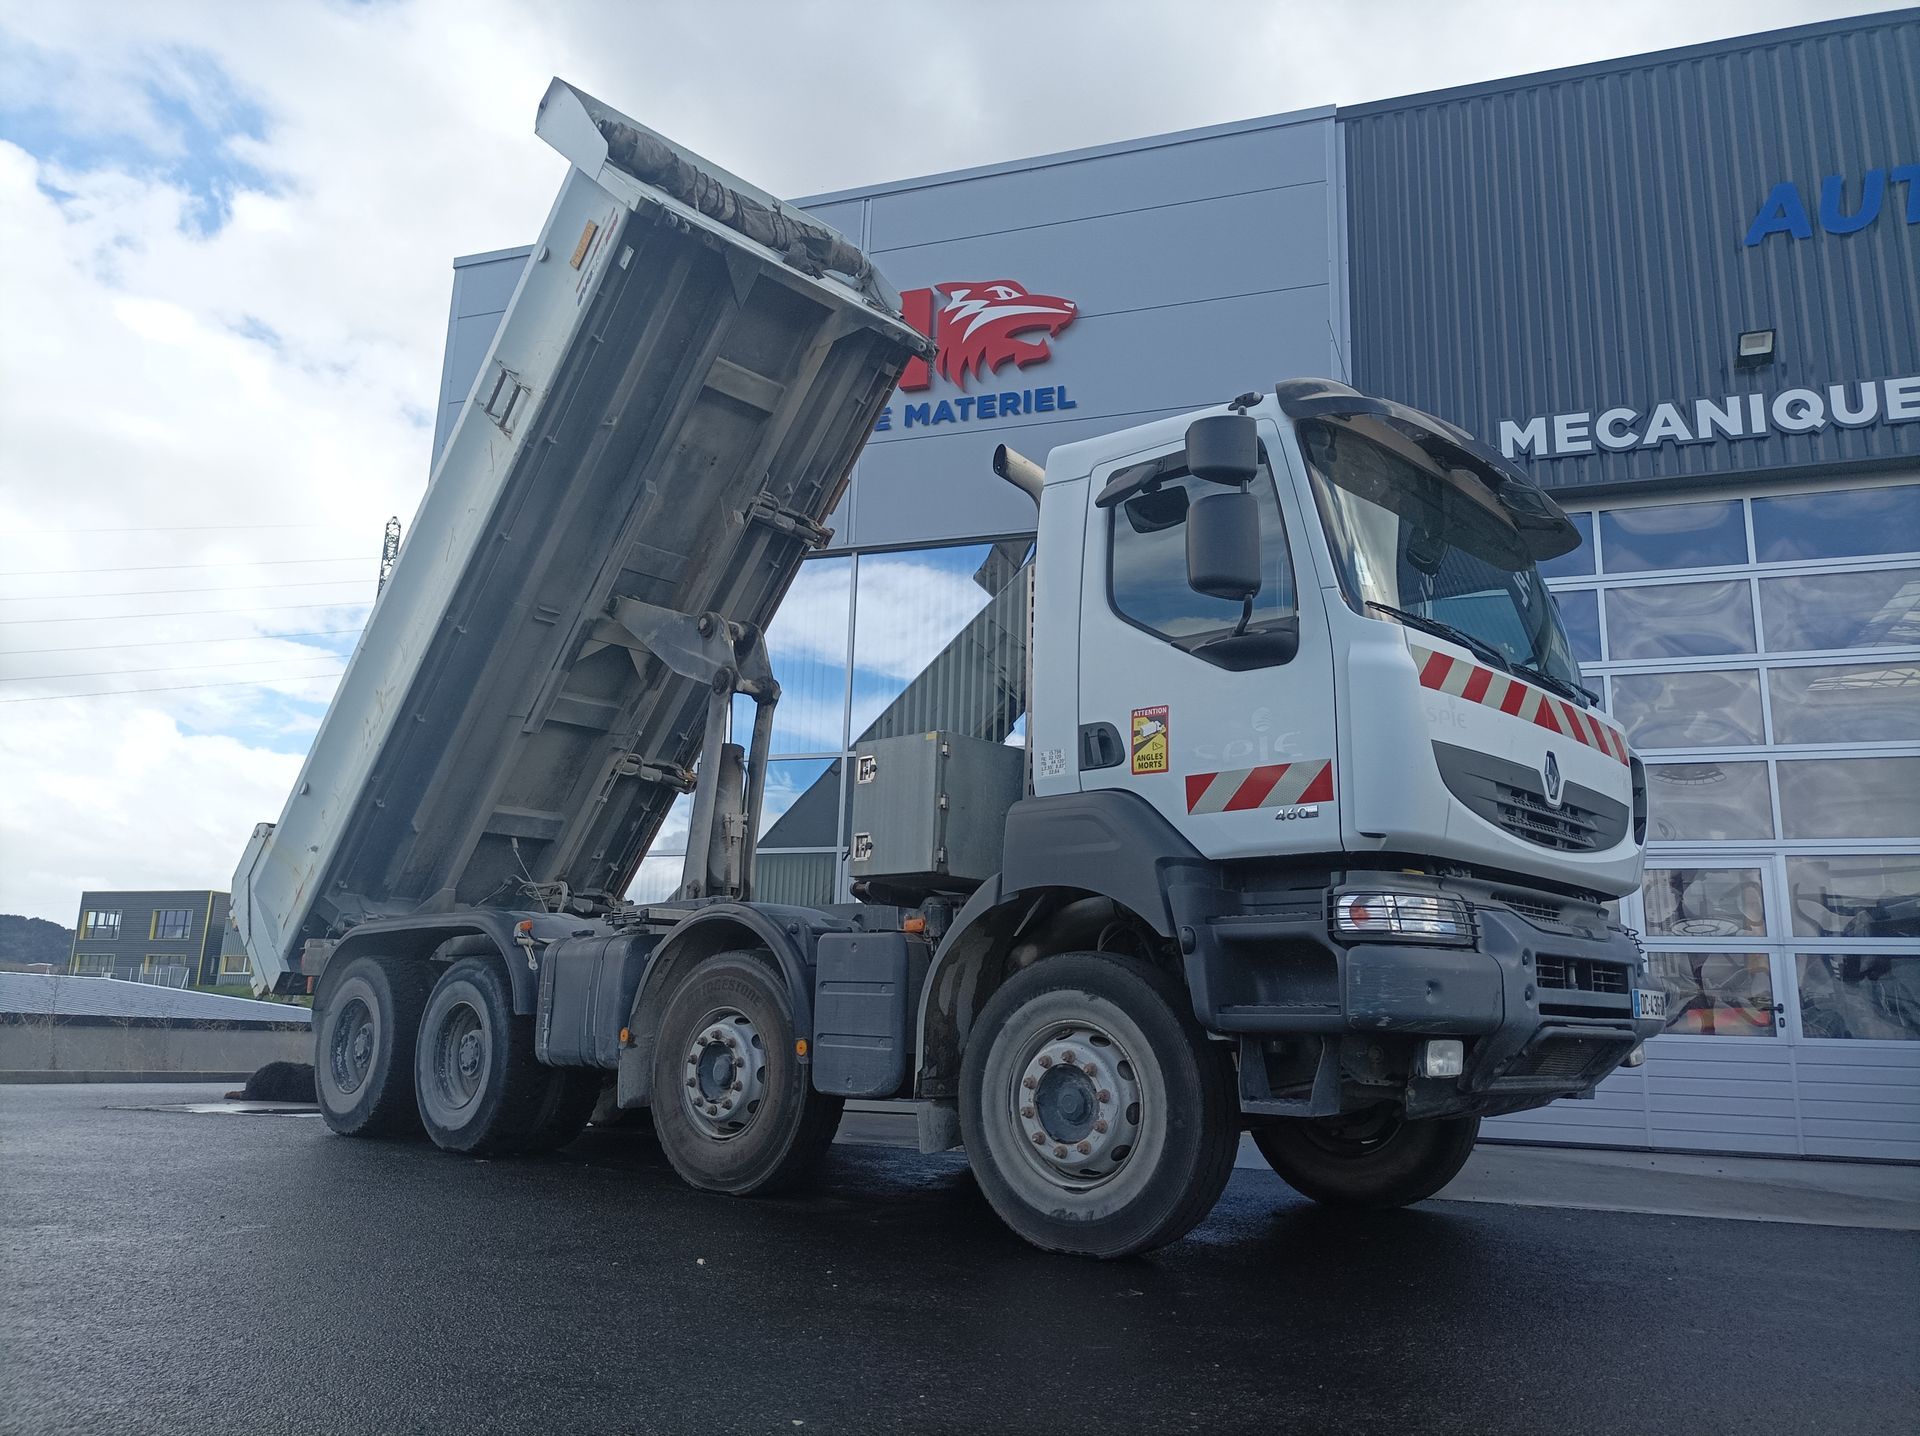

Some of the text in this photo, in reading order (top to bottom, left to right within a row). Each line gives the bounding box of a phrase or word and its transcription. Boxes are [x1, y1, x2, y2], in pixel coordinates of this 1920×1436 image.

[905, 386, 1077, 428] MATERIEL
[1499, 376, 1920, 459] MECANIQUE
[1133, 706, 1167, 717] ATTENTION
[1136, 752, 1163, 762] ANGLES
[1138, 761, 1162, 769] MORTS
[1275, 807, 1307, 821] 460
